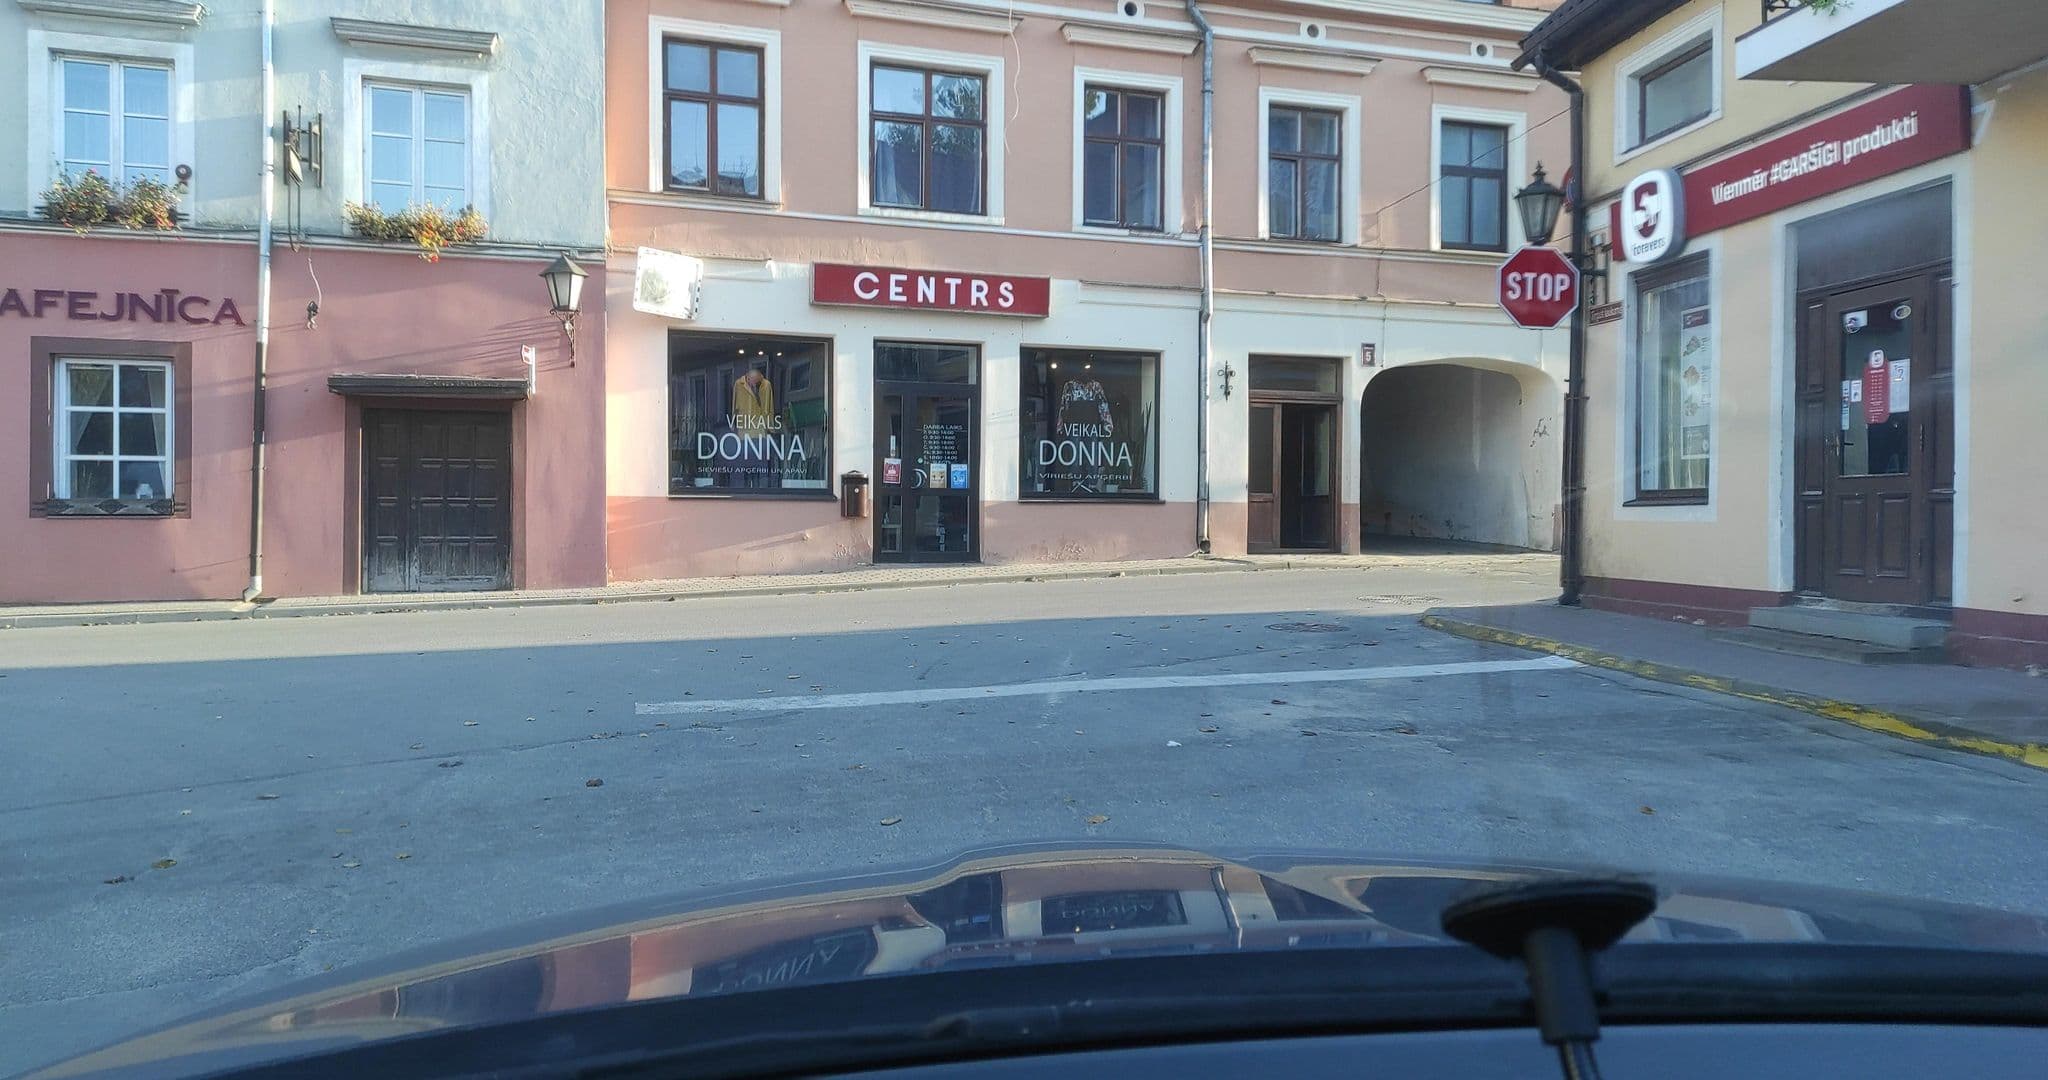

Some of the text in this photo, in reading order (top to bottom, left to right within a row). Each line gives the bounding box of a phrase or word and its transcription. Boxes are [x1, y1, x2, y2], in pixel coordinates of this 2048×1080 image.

[1842, 111, 1919, 165] produkti
[853, 271, 1015, 308] CENTRS
[1507, 271, 1570, 301] STOP
[726, 414, 782, 430] VEIKALS
[1064, 422, 1112, 438] VEIKALS
[697, 432, 806, 461] DONNA
[1039, 440, 1132, 467] DONNA
